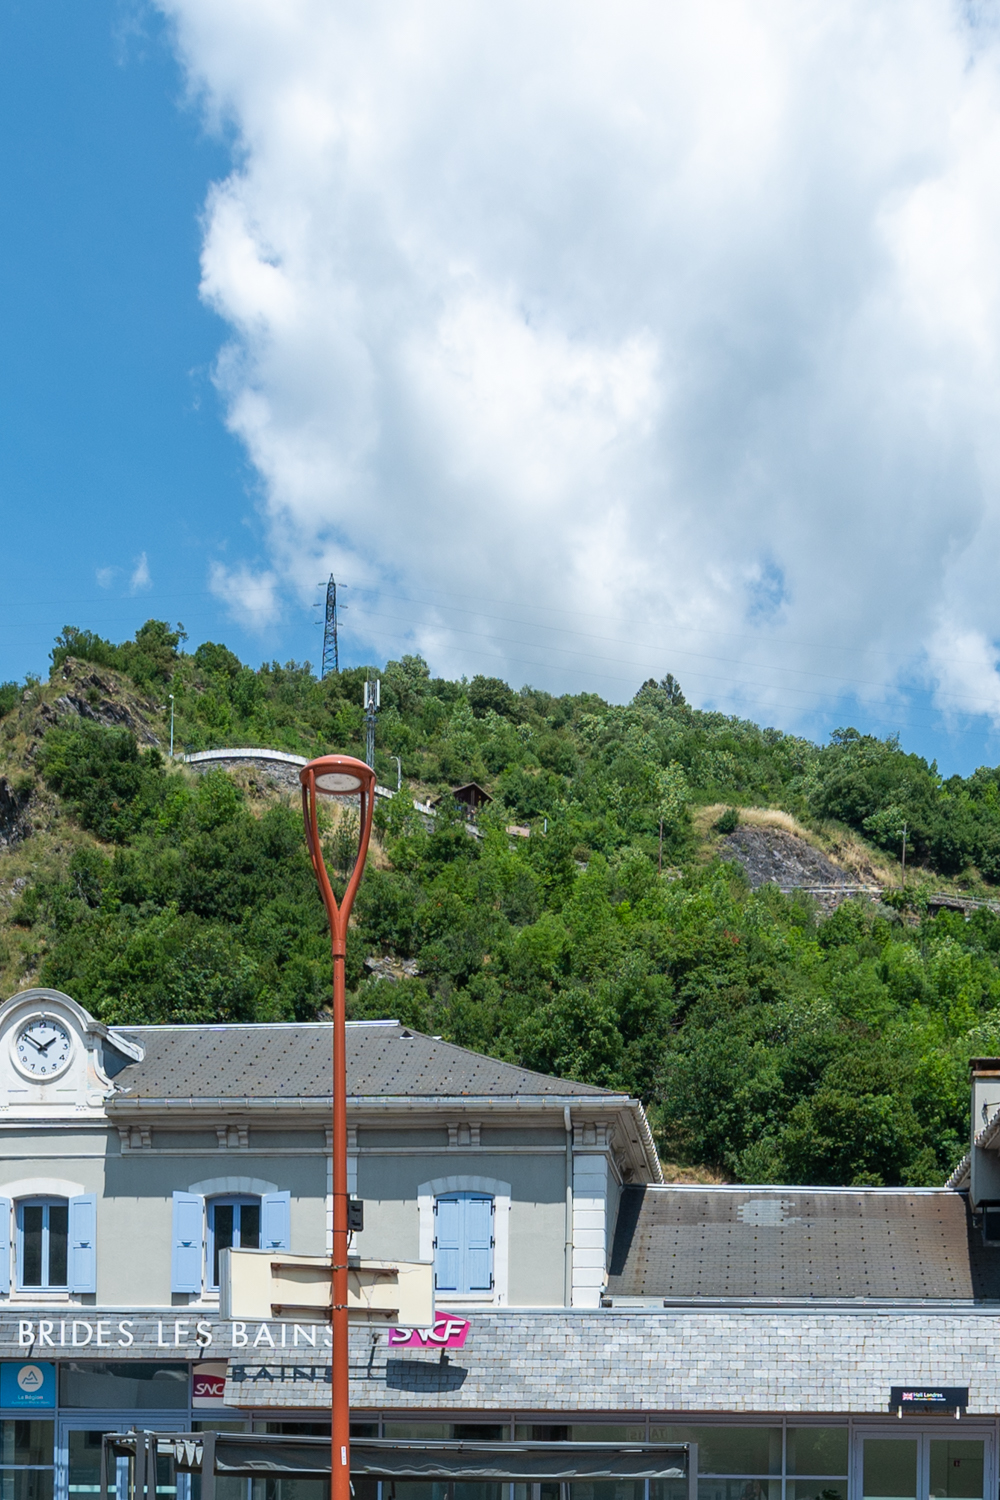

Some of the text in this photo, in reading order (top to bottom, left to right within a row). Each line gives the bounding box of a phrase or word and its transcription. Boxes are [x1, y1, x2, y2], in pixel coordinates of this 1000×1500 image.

[18, 1320, 134, 1347] BRIDES
[157, 1320, 213, 1347] LES
[194, 1382, 224, 1396] SNC
